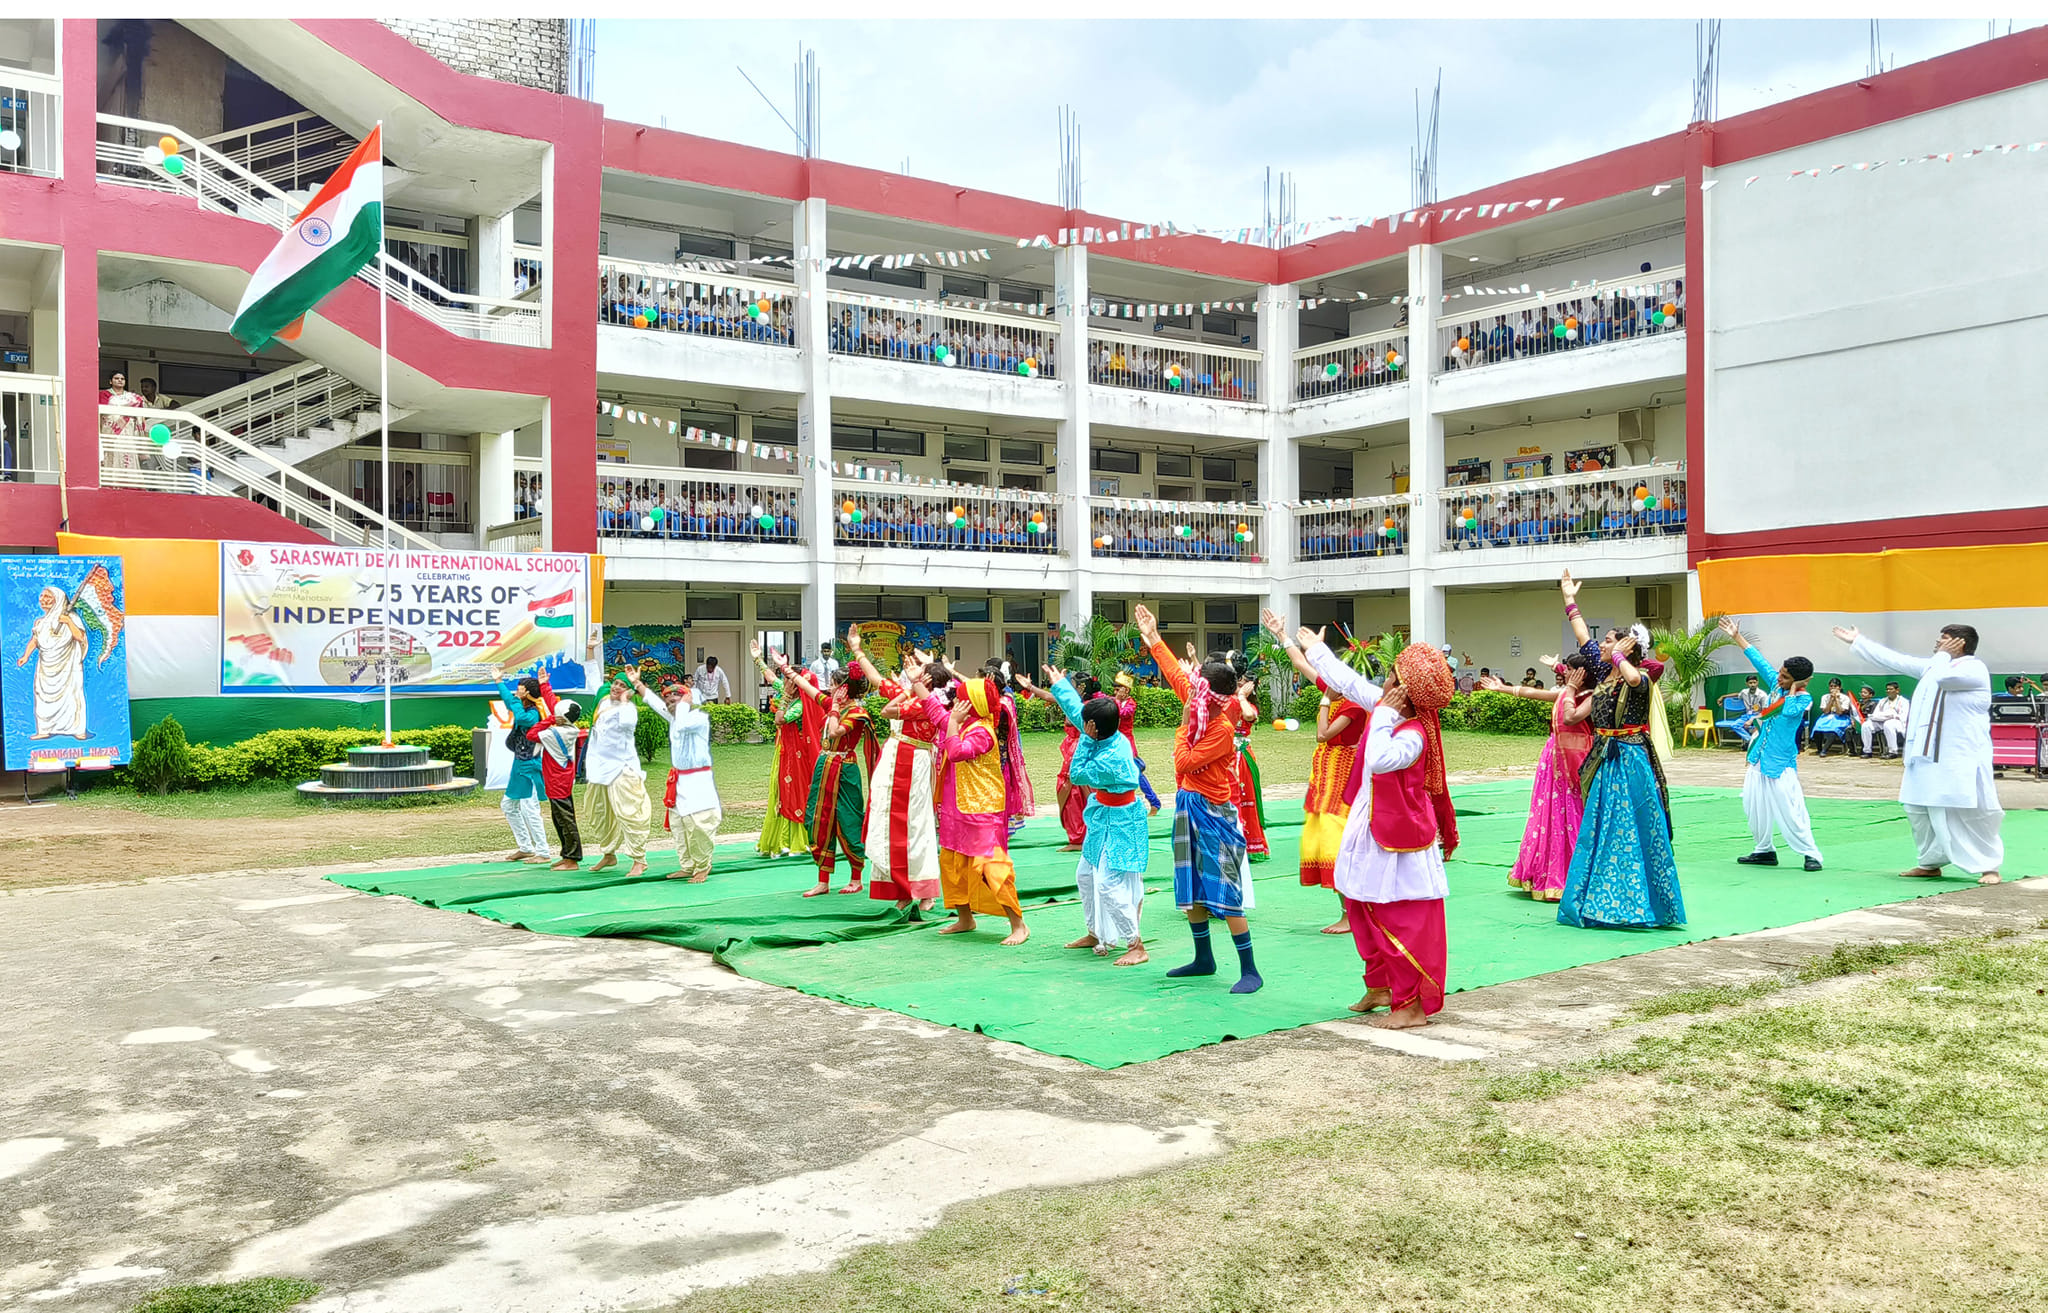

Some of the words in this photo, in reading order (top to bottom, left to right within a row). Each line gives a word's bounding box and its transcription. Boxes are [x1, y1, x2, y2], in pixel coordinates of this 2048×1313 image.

[9, 100, 27, 109] EXIT
[10, 354, 28, 363] EXIT
[270, 549, 359, 567] SARASWATI
[365, 552, 400, 569] DEVI
[406, 553, 522, 572] INTERNATIONAL
[527, 557, 581, 573] SCHOOL
[417, 572, 471, 581] CELEBRATING
[375, 584, 402, 602] 75
[411, 584, 483, 604] YEARS
[491, 586, 520, 604] OF
[273, 606, 501, 626] INDEPENDENCE
[437, 630, 503, 647] 2022
